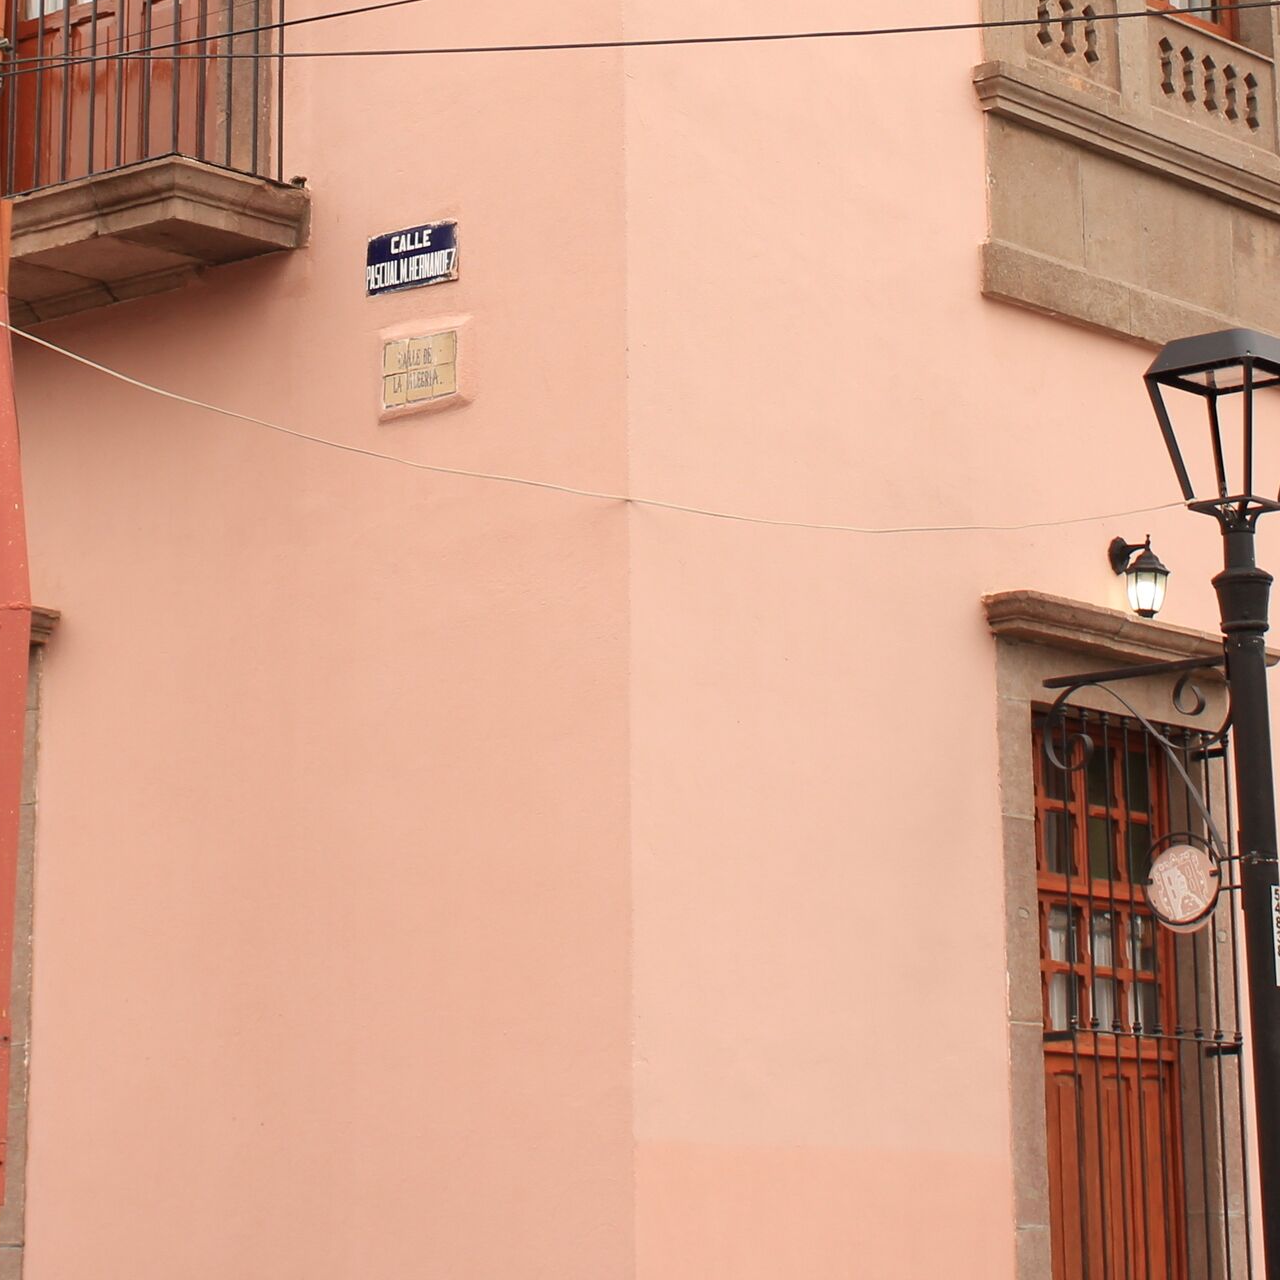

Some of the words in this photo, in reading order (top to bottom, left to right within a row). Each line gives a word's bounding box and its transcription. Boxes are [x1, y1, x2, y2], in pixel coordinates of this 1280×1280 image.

[390, 229, 432, 255] CALLE
[366, 260, 401, 290] PASCUAL
[392, 376, 403, 394] LA
